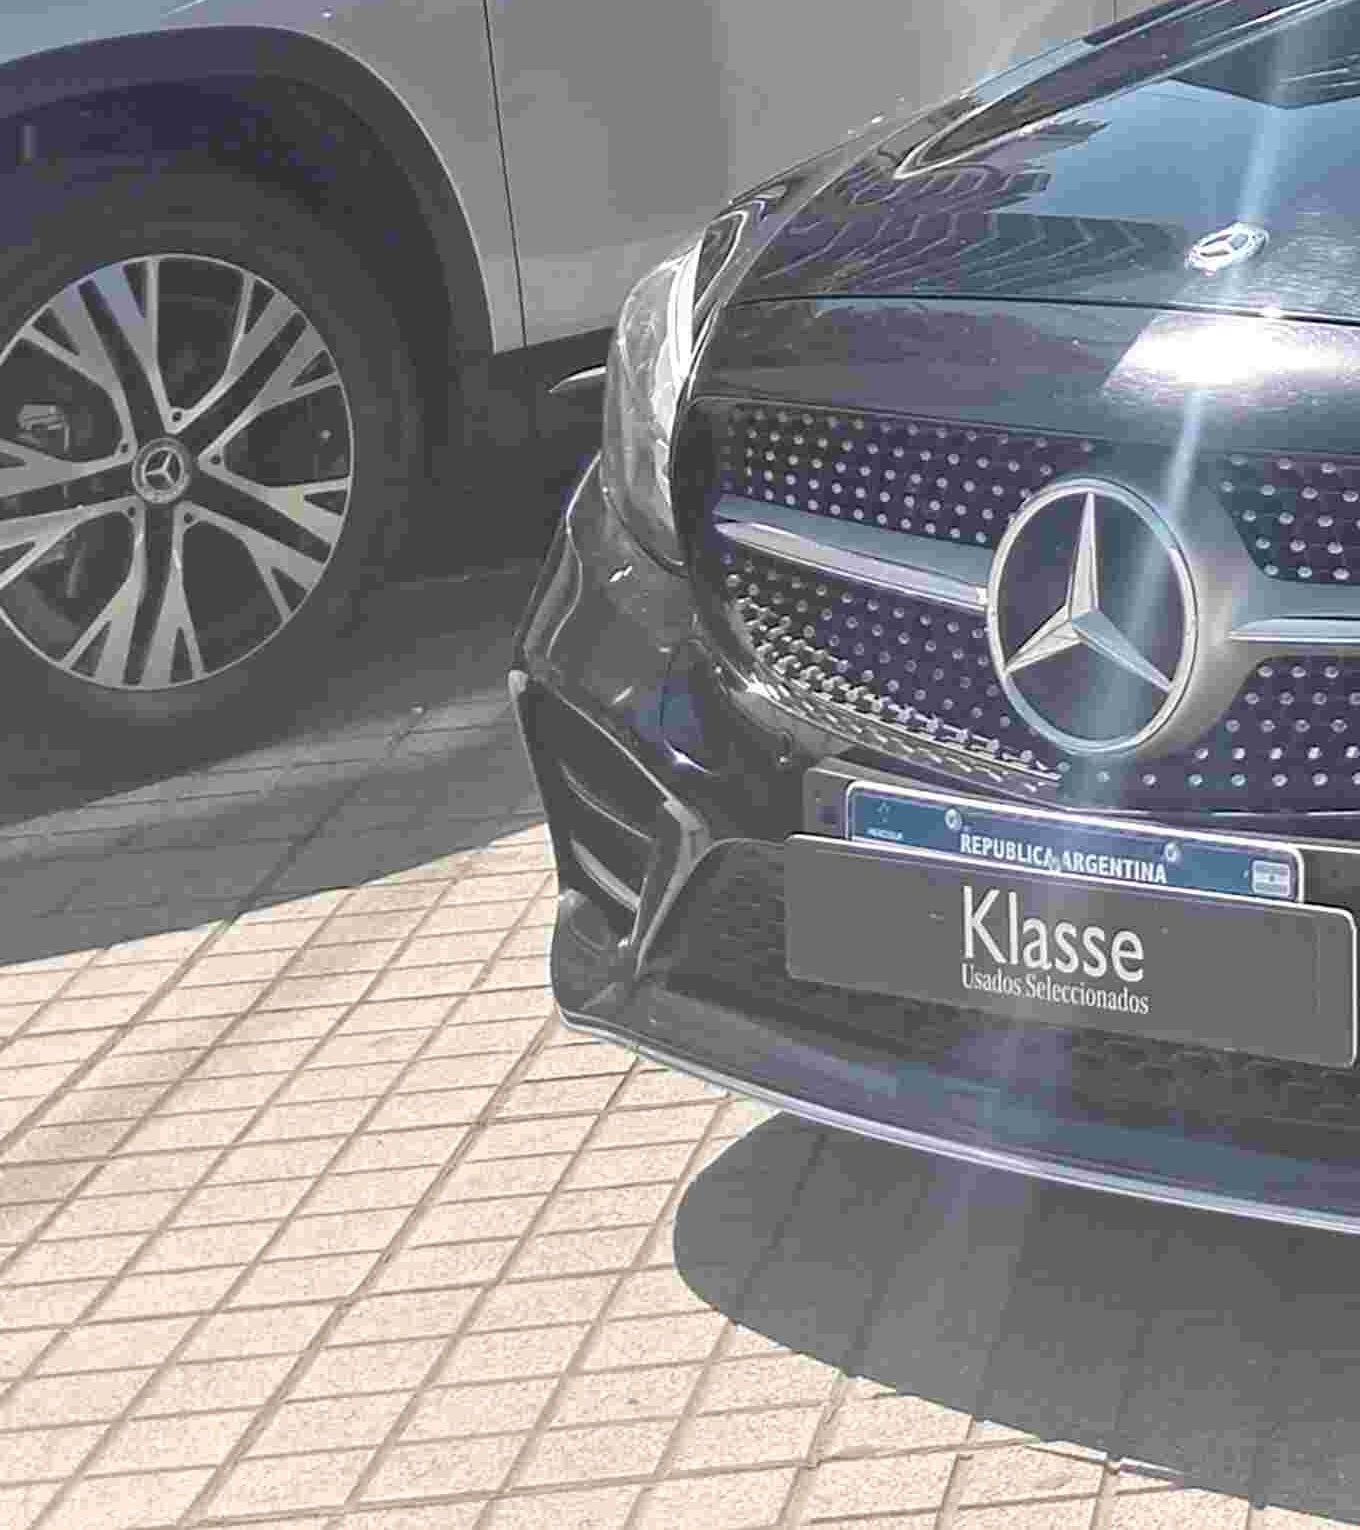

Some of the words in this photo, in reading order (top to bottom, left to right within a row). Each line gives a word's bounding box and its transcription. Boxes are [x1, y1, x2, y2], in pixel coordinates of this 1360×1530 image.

[960, 832, 1054, 868] REPUBLICA
[1059, 850, 1168, 884] ARGENTINA
[960, 885, 1145, 982] Klasse
[961, 962, 1022, 997] Usados
[1024, 972, 1150, 1015] Seleccionados
